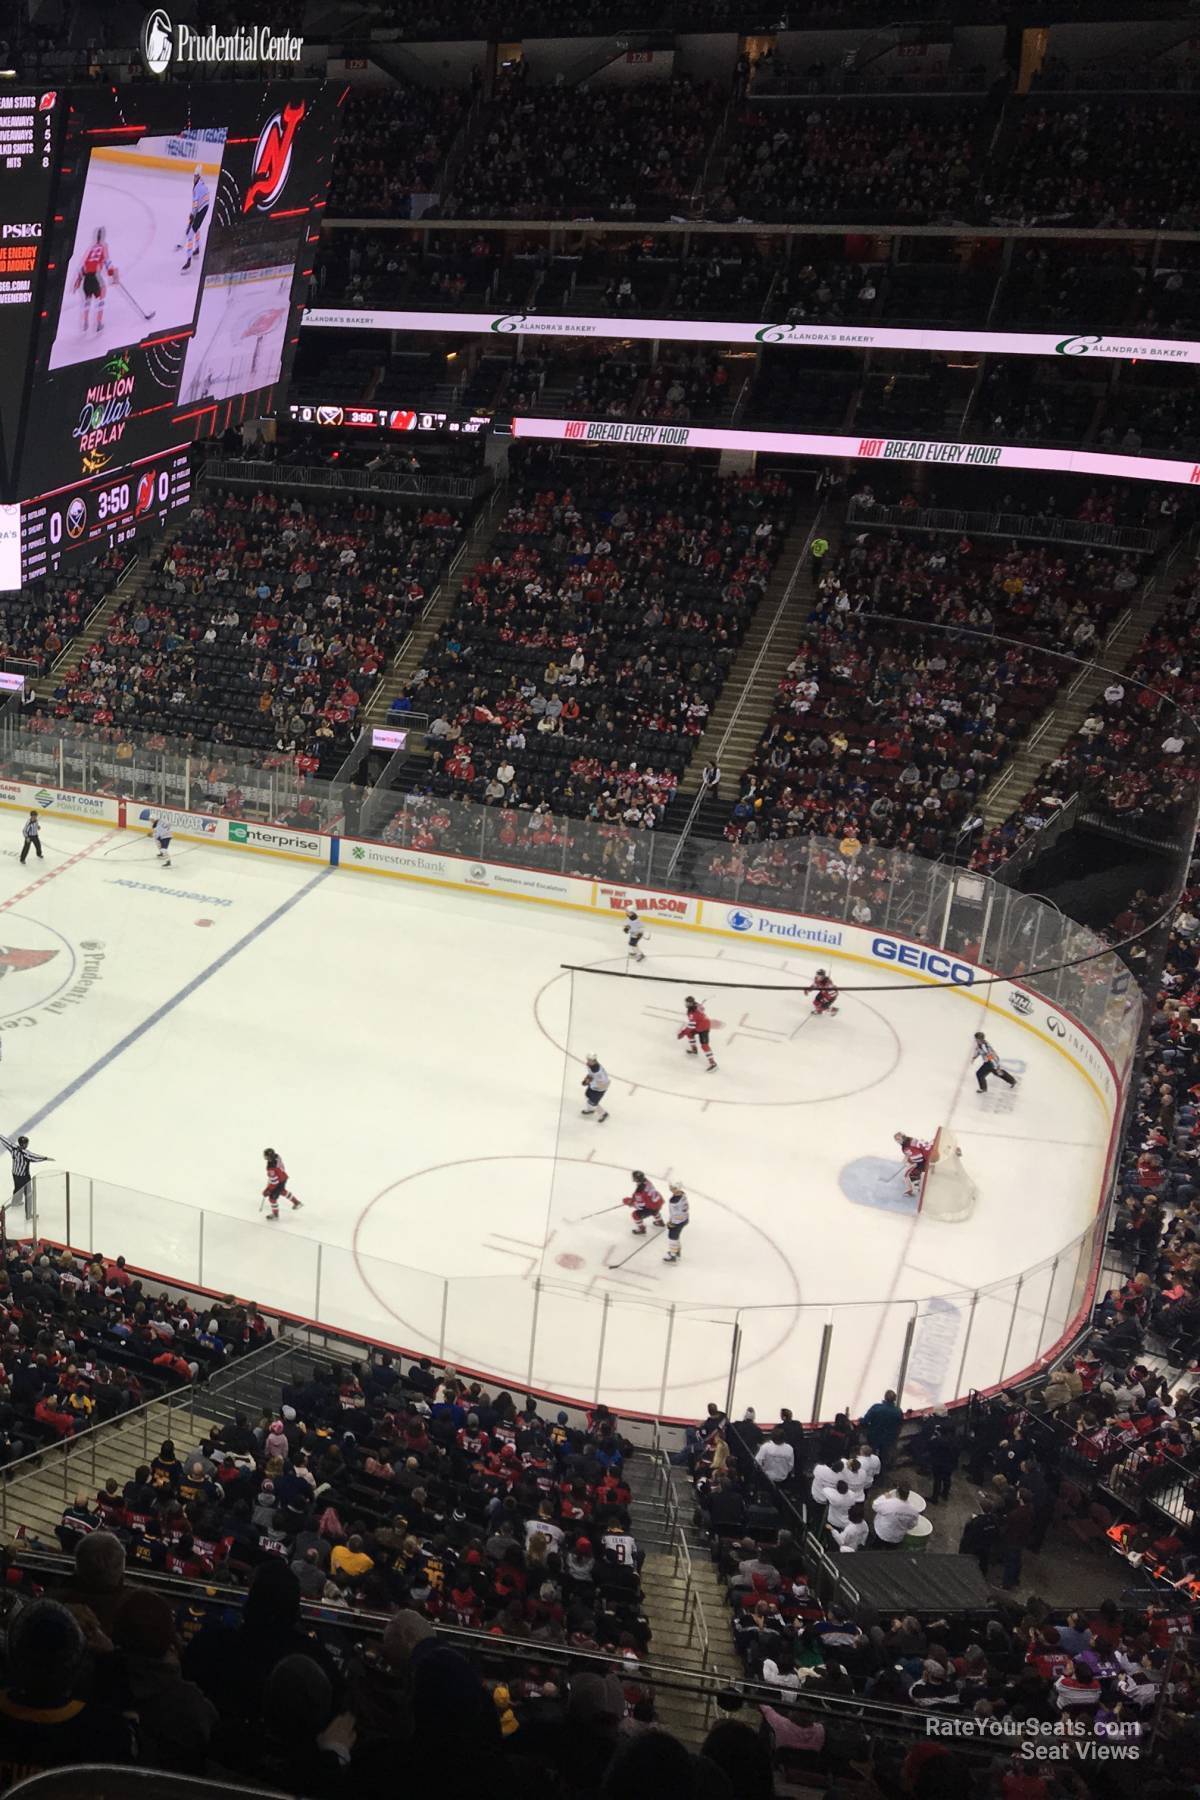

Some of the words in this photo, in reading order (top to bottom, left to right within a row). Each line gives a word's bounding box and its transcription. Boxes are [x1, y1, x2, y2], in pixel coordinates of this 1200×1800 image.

[176, 25, 258, 62] Prudential
[260, 26, 304, 61] Center
[14, 96, 36, 108] STATS
[45, 115, 50, 126] 1
[44, 129, 51, 140] 5
[44, 143, 51, 153] 4
[7, 157, 21, 168] HITS
[42, 157, 49, 167] 8
[2, 223, 42, 238] PSEG
[8, 245, 37, 259] ENERGY
[7, 259, 35, 272] MONEY
[305, 315, 345, 324] ALANDRA'S
[346, 317, 374, 325] BAKERY
[565, 324, 597, 332] BAKERY
[840, 334, 875, 343] BAKERY
[1150, 347, 1189, 358] BAKERY
[86, 376, 134, 403] MILLION
[352, 412, 373, 423] 3:50
[423, 415, 432, 428] 0
[80, 422, 125, 452] REPLAY
[564, 422, 586, 437] HOT
[587, 422, 622, 440] BREAD
[623, 424, 657, 443] EVERY
[658, 427, 690, 444] HOUR
[858, 440, 884, 457] HOT
[884, 441, 925, 459] BREAD
[926, 443, 965, 463] EVERY
[965, 446, 1002, 464] HOUR
[159, 472, 169, 502] 0
[98, 484, 129, 519] 3:50
[50, 512, 62, 544] 0
[57, 793, 76, 803] EAST
[79, 797, 104, 807] COAST
[57, 803, 81, 813] POWER
[234, 826, 318, 851] enterprise
[368, 849, 447, 873] investorsBank
[635, 898, 687, 914] MASON
[758, 917, 842, 946] Prudential
[872, 938, 975, 987] GEICO
[43, 953, 105, 1015] Prudential
